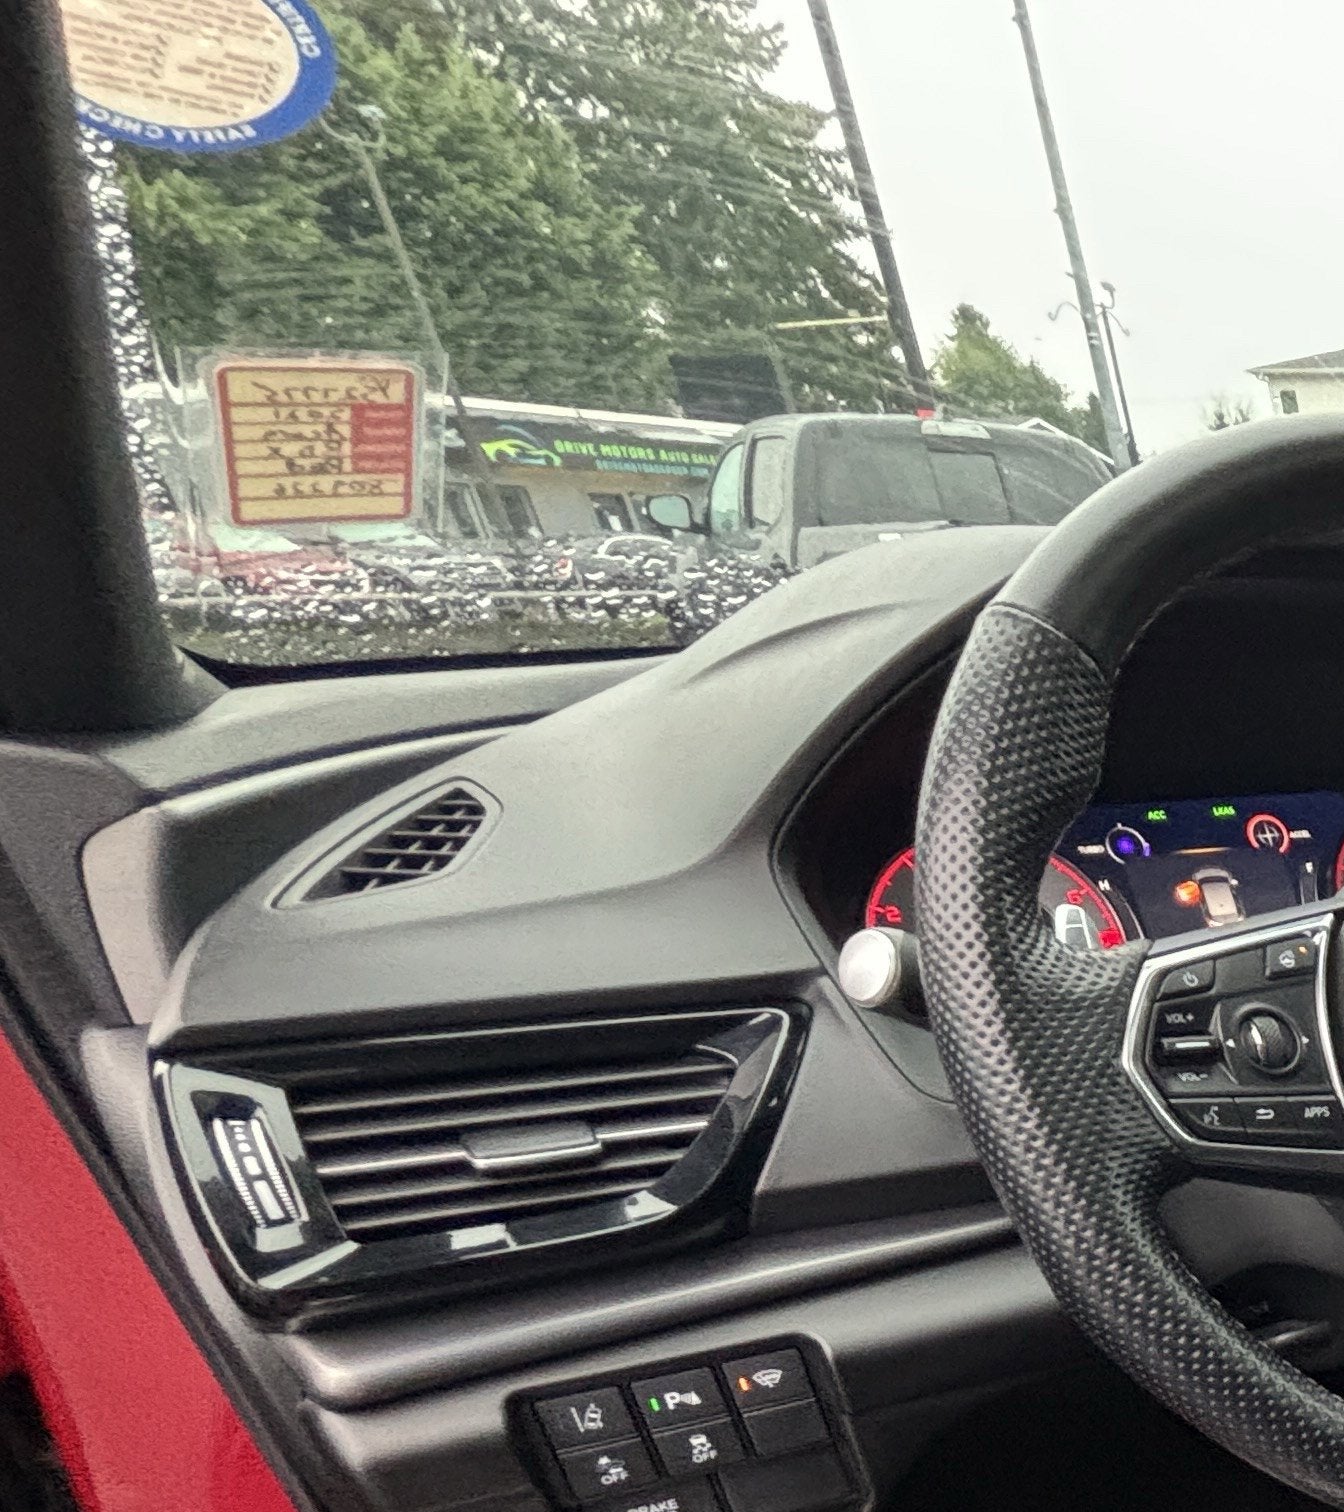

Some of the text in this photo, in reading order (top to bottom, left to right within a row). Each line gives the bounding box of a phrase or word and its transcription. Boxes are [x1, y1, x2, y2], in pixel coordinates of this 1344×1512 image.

[600, 443, 656, 460] MOTORS
[1148, 810, 1167, 820] ACC
[1303, 1105, 1331, 1119] APPS
[691, 1448, 718, 1463] OFF
[600, 1470, 629, 1485] OFF
